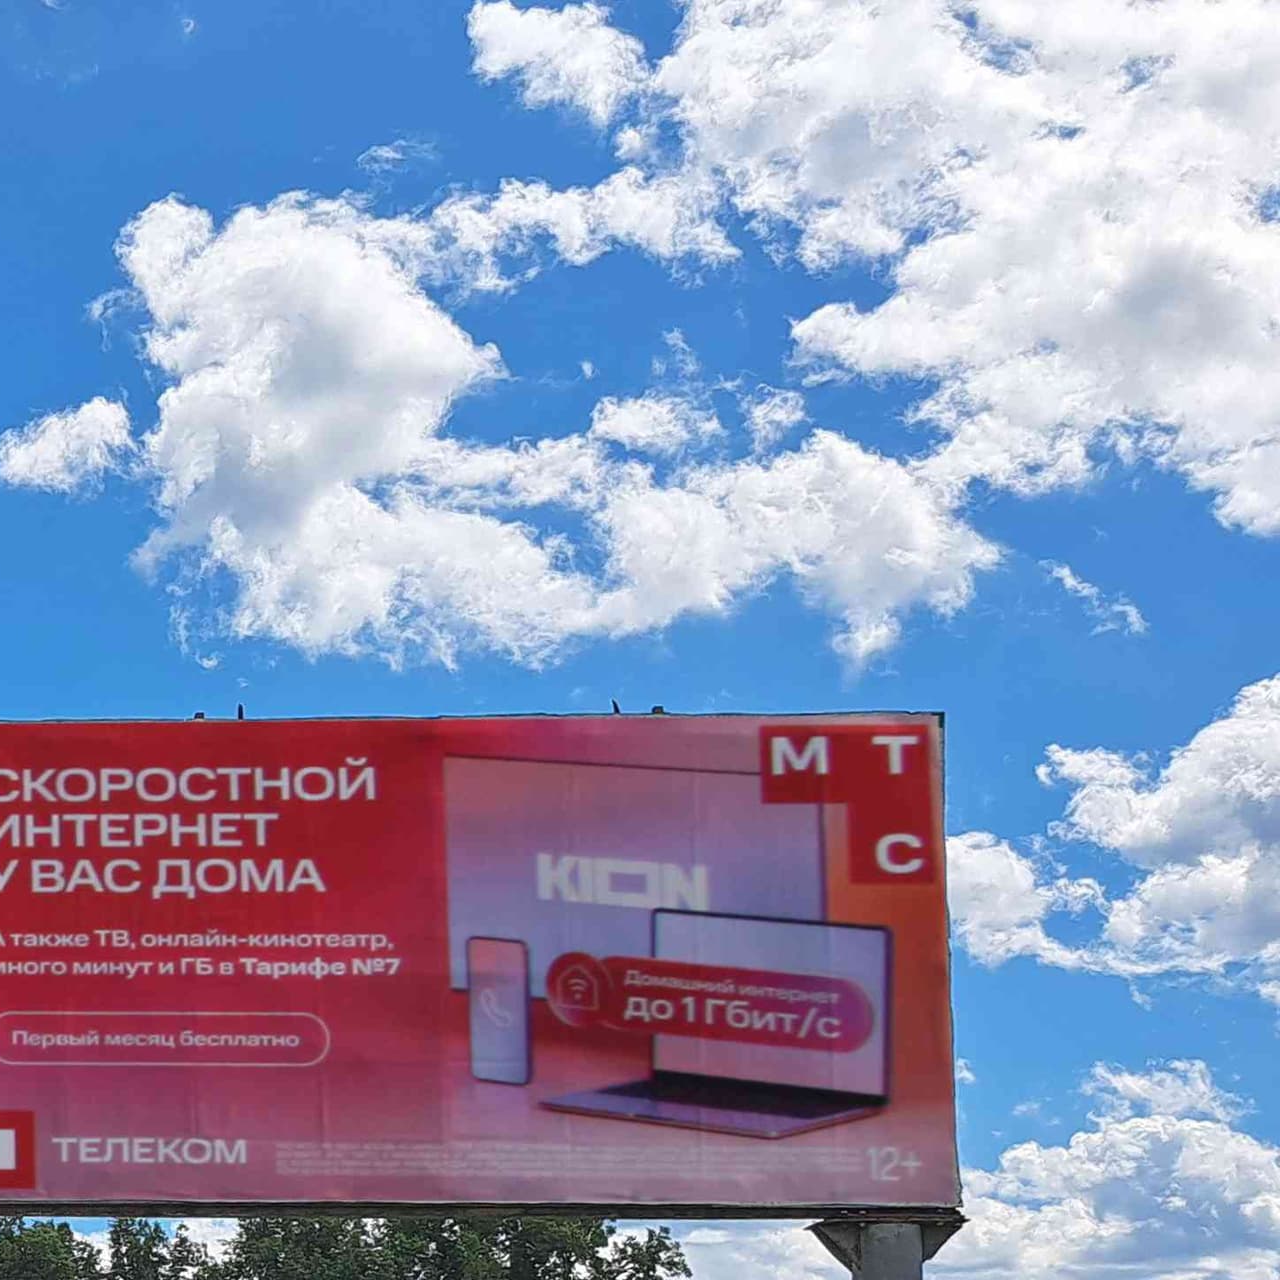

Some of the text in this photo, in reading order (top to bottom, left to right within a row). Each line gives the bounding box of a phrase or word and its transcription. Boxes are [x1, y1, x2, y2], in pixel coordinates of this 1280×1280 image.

[770, 735, 919, 776] М Т
[31, 859, 142, 893] ВАС
[152, 858, 326, 900] ДОМА
[10, 931, 88, 948] также
[93, 930, 136, 950] ТВ,
[140, 929, 395, 951] онлайн-кинотеатр,
[72, 960, 153, 979] минут
[159, 960, 175, 975] и
[180, 957, 214, 975] ГБ
[219, 960, 234, 975] в
[240, 958, 345, 980] Тарифе
[352, 957, 401, 975] №7
[623, 969, 735, 994] Домашний
[623, 996, 842, 1039] до 1 Гбит/с
[11, 1030, 301, 1050] Первый месяц бесплатно
[51, 1137, 248, 1165] ТЕЛЕКОМ
[865, 1146, 923, 1181] 12+
